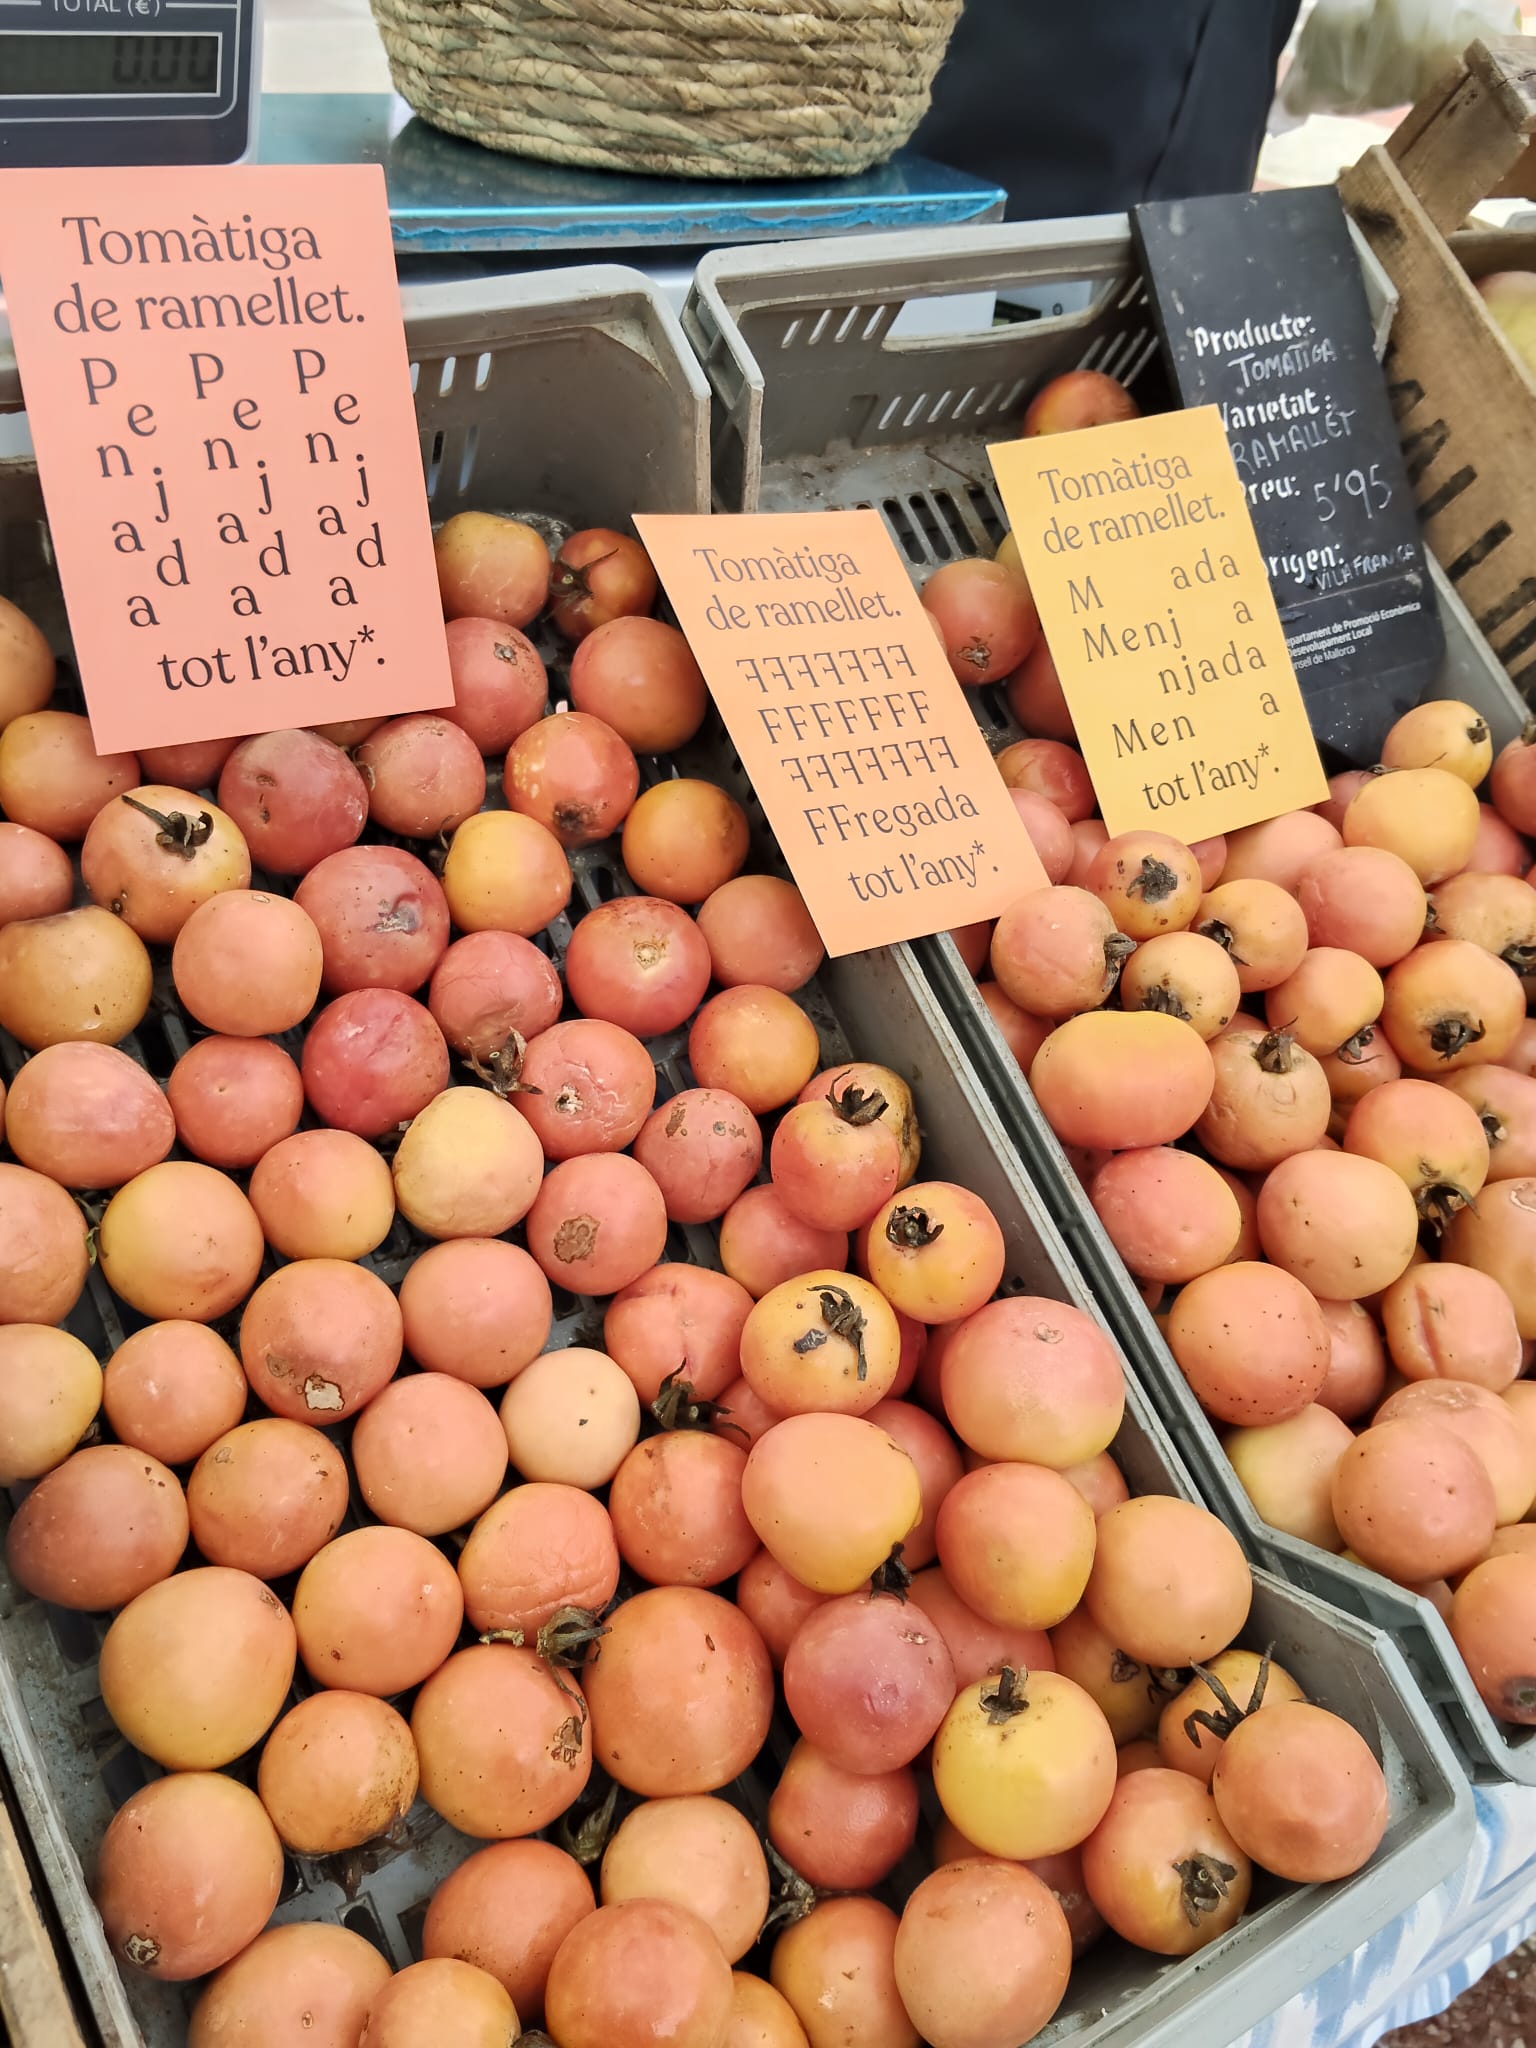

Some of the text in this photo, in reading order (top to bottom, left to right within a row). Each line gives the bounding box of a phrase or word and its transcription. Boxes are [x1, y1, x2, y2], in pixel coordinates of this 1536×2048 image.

[61, 213, 323, 271] Tomàtiga
[53, 274, 369, 334] de ramellet.
[1194, 313, 1317, 357] Producte:
[1036, 452, 1194, 505] Tomàtiga
[1241, 476, 1300, 504] reu:
[1043, 491, 1226, 554] de ramellet.
[692, 545, 862, 584] Tomàtiga
[1066, 547, 1241, 615] M ada
[1263, 543, 1344, 583] rigen:
[705, 586, 902, 631] de ramellet.
[1081, 600, 1254, 663] Menj a
[156, 647, 237, 691] tot
[1157, 639, 1268, 697] njada
[757, 690, 932, 745] FFFFFFF
[1111, 692, 1281, 759] Men a
[802, 785, 981, 847] FFregada
[1141, 773, 1191, 811] tot
[847, 864, 904, 902] tot
